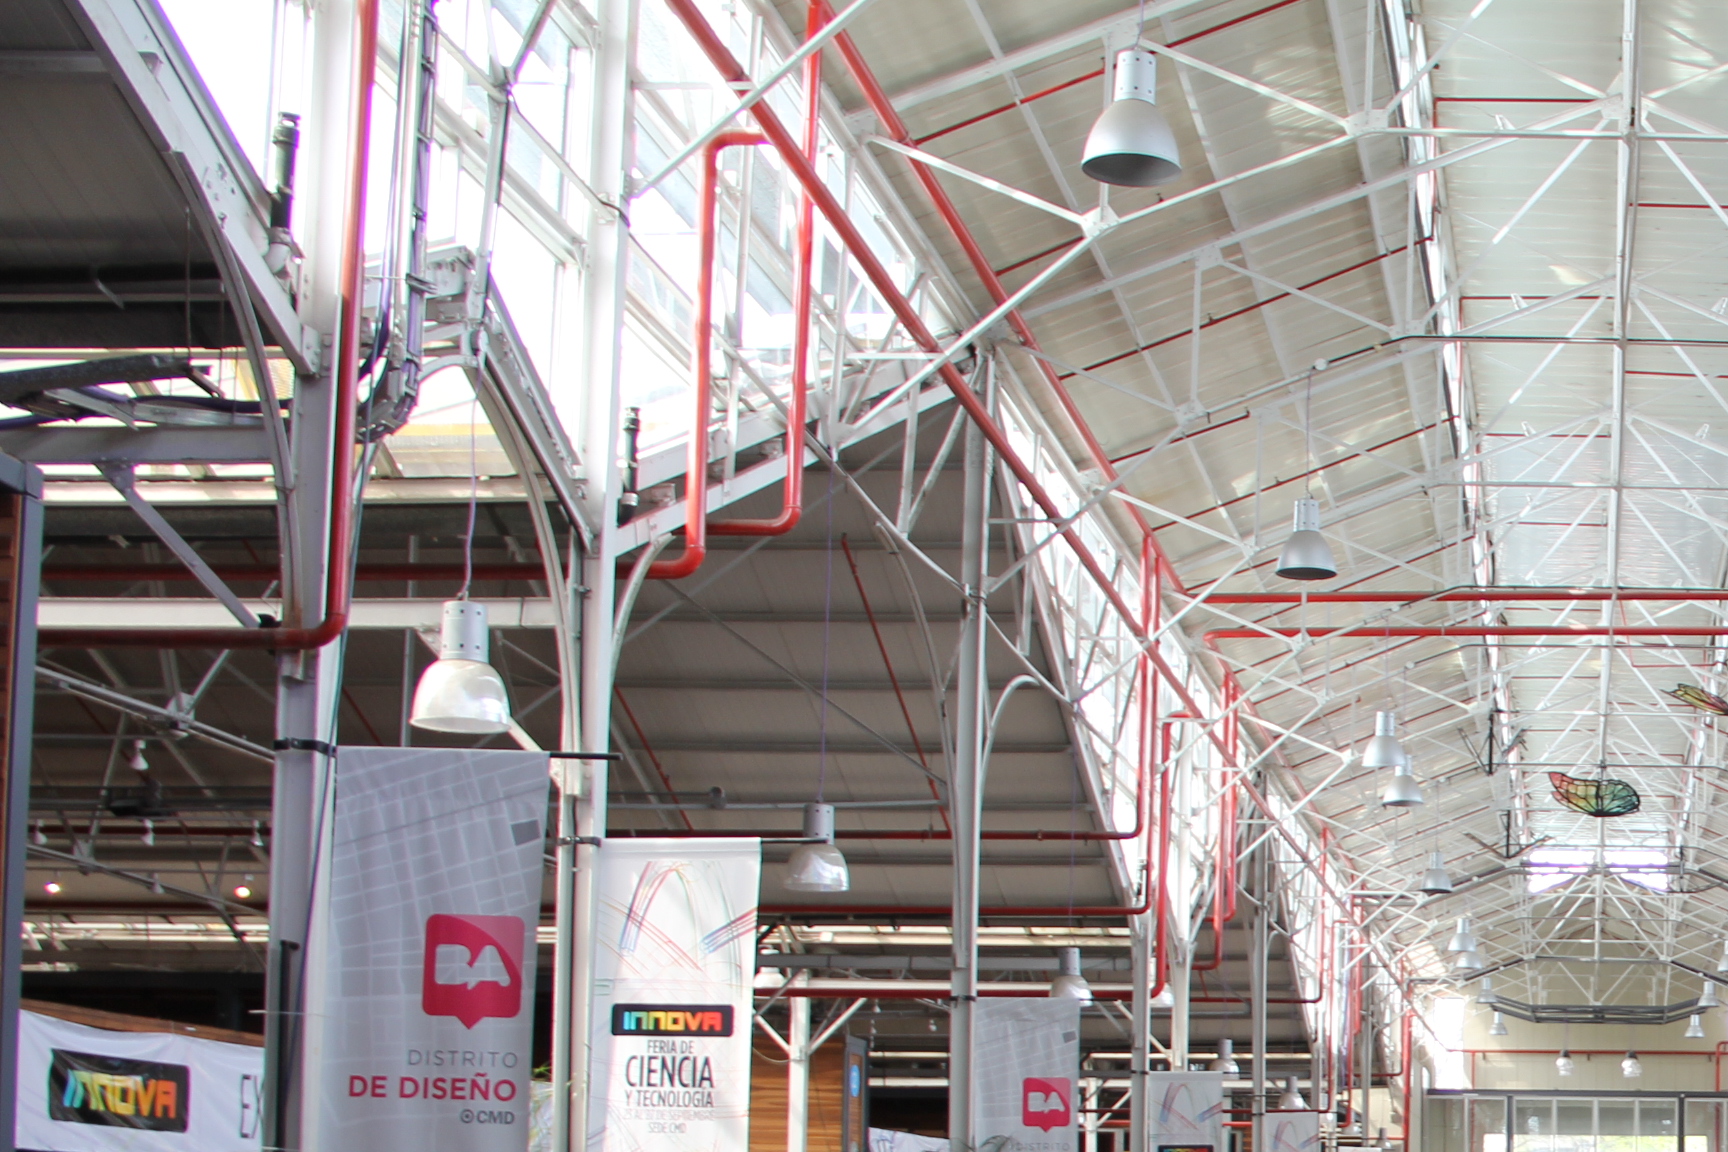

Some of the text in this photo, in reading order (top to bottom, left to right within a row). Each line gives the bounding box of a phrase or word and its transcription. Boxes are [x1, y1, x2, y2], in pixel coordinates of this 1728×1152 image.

[434, 943, 511, 990] BA
[623, 1011, 722, 1031] INNOVA
[407, 1050, 518, 1068] DISTRITO
[647, 1040, 695, 1054] FERIA DE
[625, 1055, 715, 1088] CIENCIA
[62, 1068, 178, 1120] INNOVA
[349, 1072, 517, 1101] DE DISEÑO
[624, 1087, 715, 1108] Y TECNOLOGÍA
